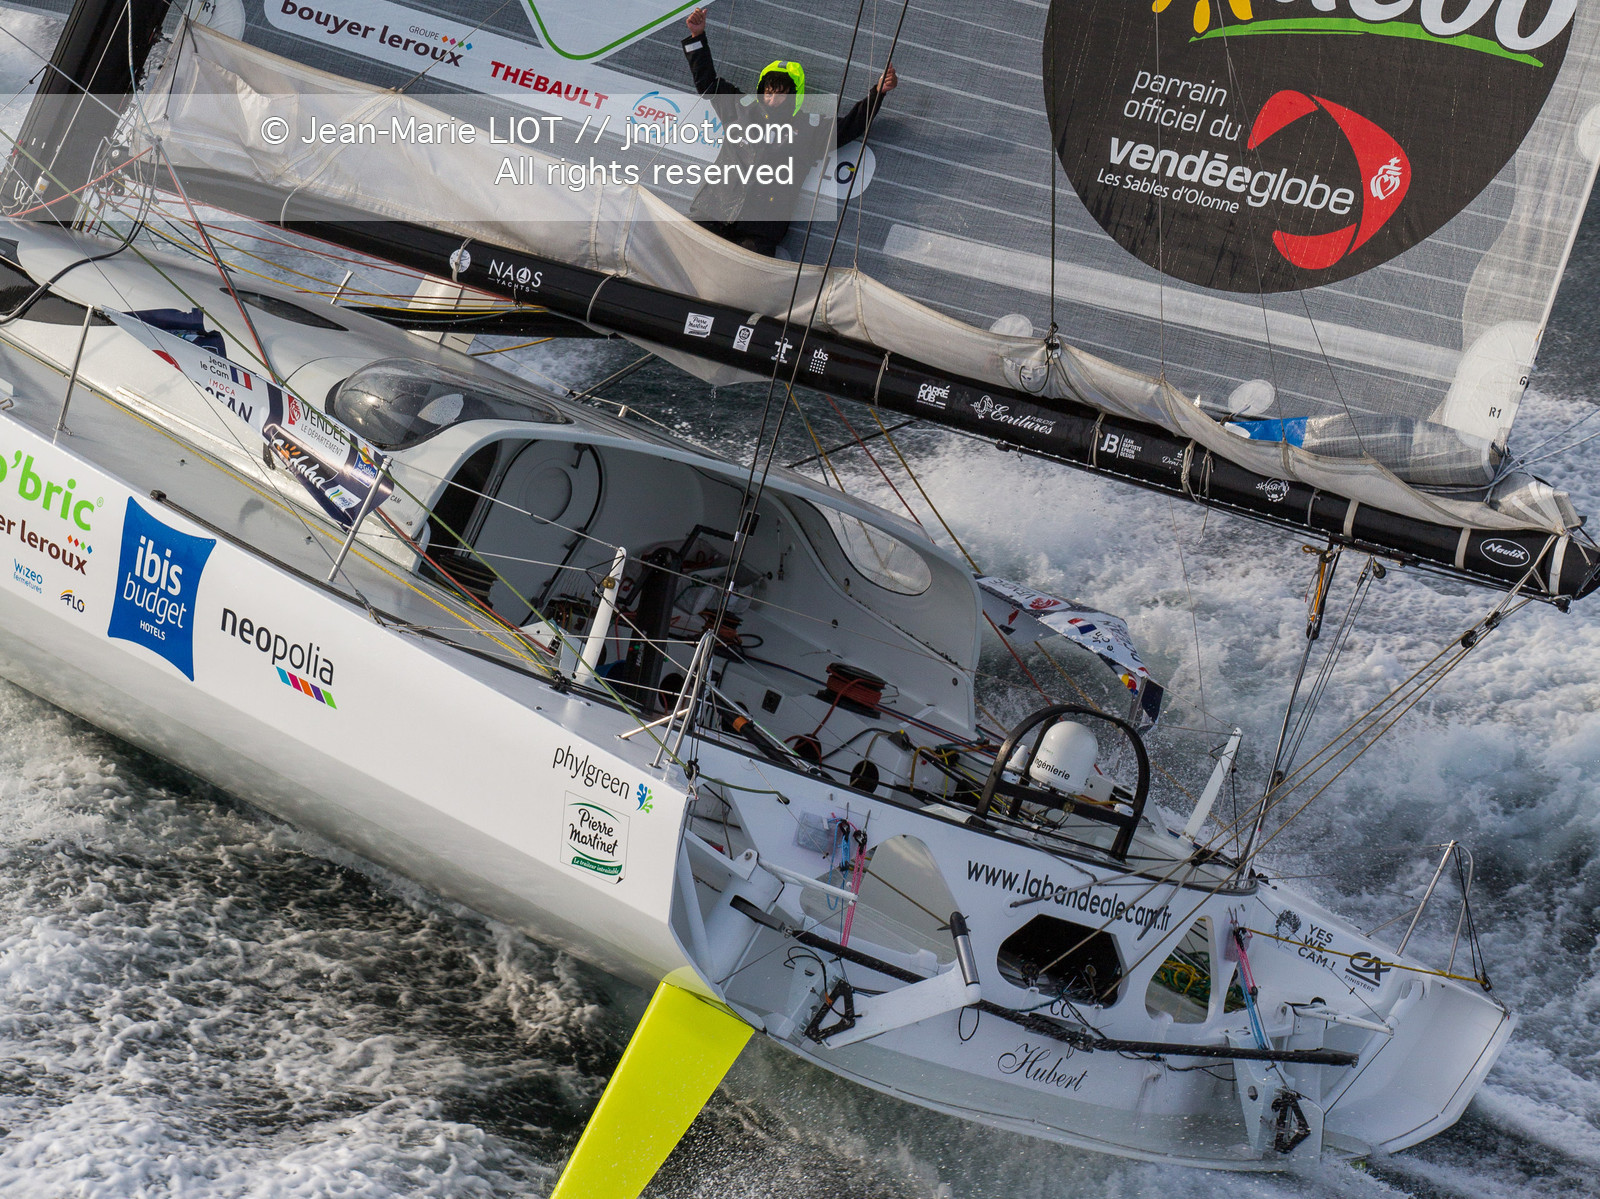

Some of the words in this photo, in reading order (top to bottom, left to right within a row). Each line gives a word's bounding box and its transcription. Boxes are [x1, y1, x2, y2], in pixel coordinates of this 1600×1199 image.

[378, 25, 464, 68] leroux
[408, 25, 440, 41] GROUPE
[489, 60, 609, 111] THÉBAULT
[1131, 70, 1228, 107] parrain
[1123, 97, 1205, 133] officiel
[1210, 114, 1242, 142] du
[1096, 168, 1120, 187] Les
[1123, 174, 1170, 200] Sables
[1171, 186, 1240, 215] d'Olonne
[488, 259, 544, 288] NAOS
[495, 278, 530, 293] YACHTS
[209, 365, 230, 380] Cam
[1519, 375, 1528, 386] 6
[208, 378, 236, 397] IMOCA
[917, 389, 936, 403] PUB
[920, 383, 951, 399] CARRÉ
[1488, 406, 1502, 419] R1
[20, 518, 88, 576] leroux
[13, 558, 43, 585] Wizeo
[134, 535, 183, 596] ibis
[60, 591, 86, 613] FLO
[123, 572, 187, 629] budget
[139, 620, 166, 641] HOTELS
[220, 607, 334, 686] neopolia
[552, 745, 630, 800] phylgreen
[578, 808, 614, 837] Pierre
[967, 859, 1172, 932] www.labandealecam.fr
[1304, 934, 1327, 954] WE
[1309, 923, 1334, 944] YES
[1297, 946, 1329, 968] CAM
[997, 1042, 1089, 1092] Hubert
